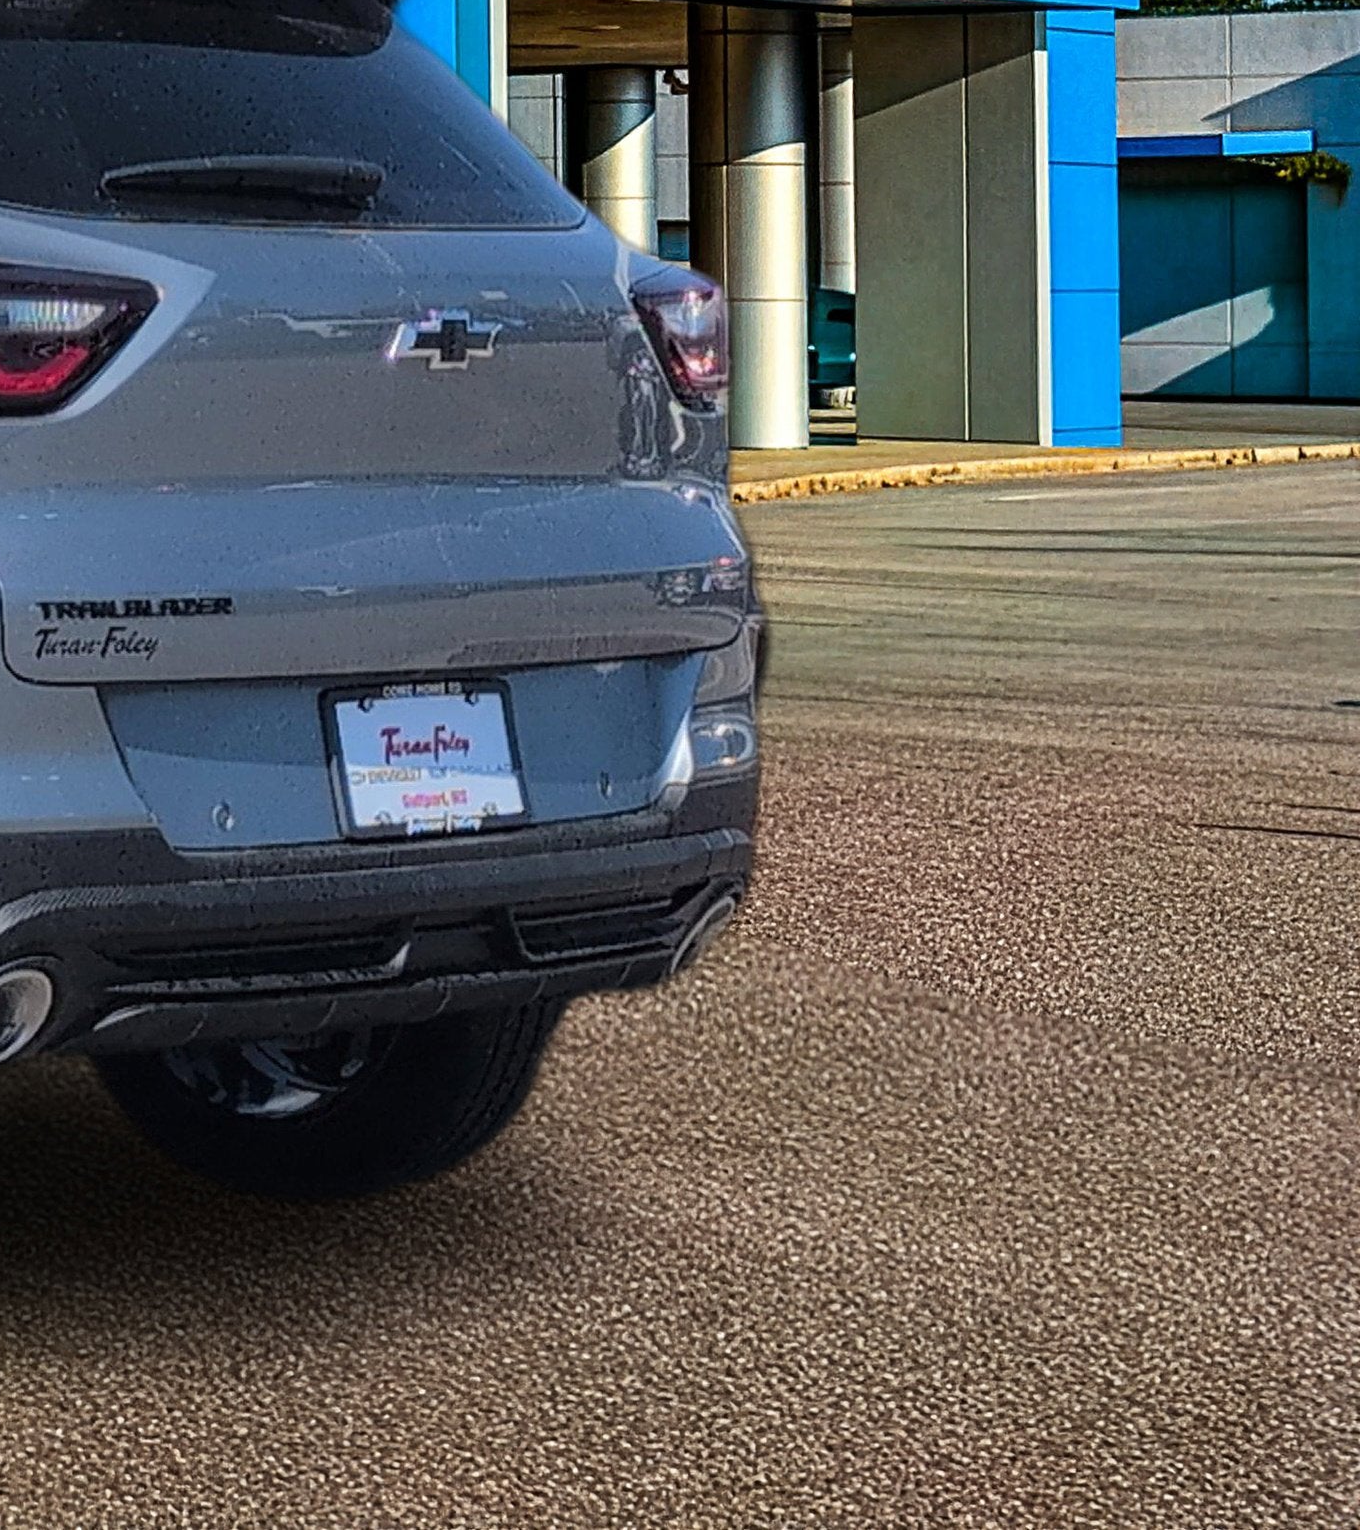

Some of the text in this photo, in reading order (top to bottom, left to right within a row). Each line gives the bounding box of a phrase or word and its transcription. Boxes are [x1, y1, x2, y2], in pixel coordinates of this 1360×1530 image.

[36, 597, 234, 620] TRAILBLAZER
[34, 625, 160, 661] Turan Foley
